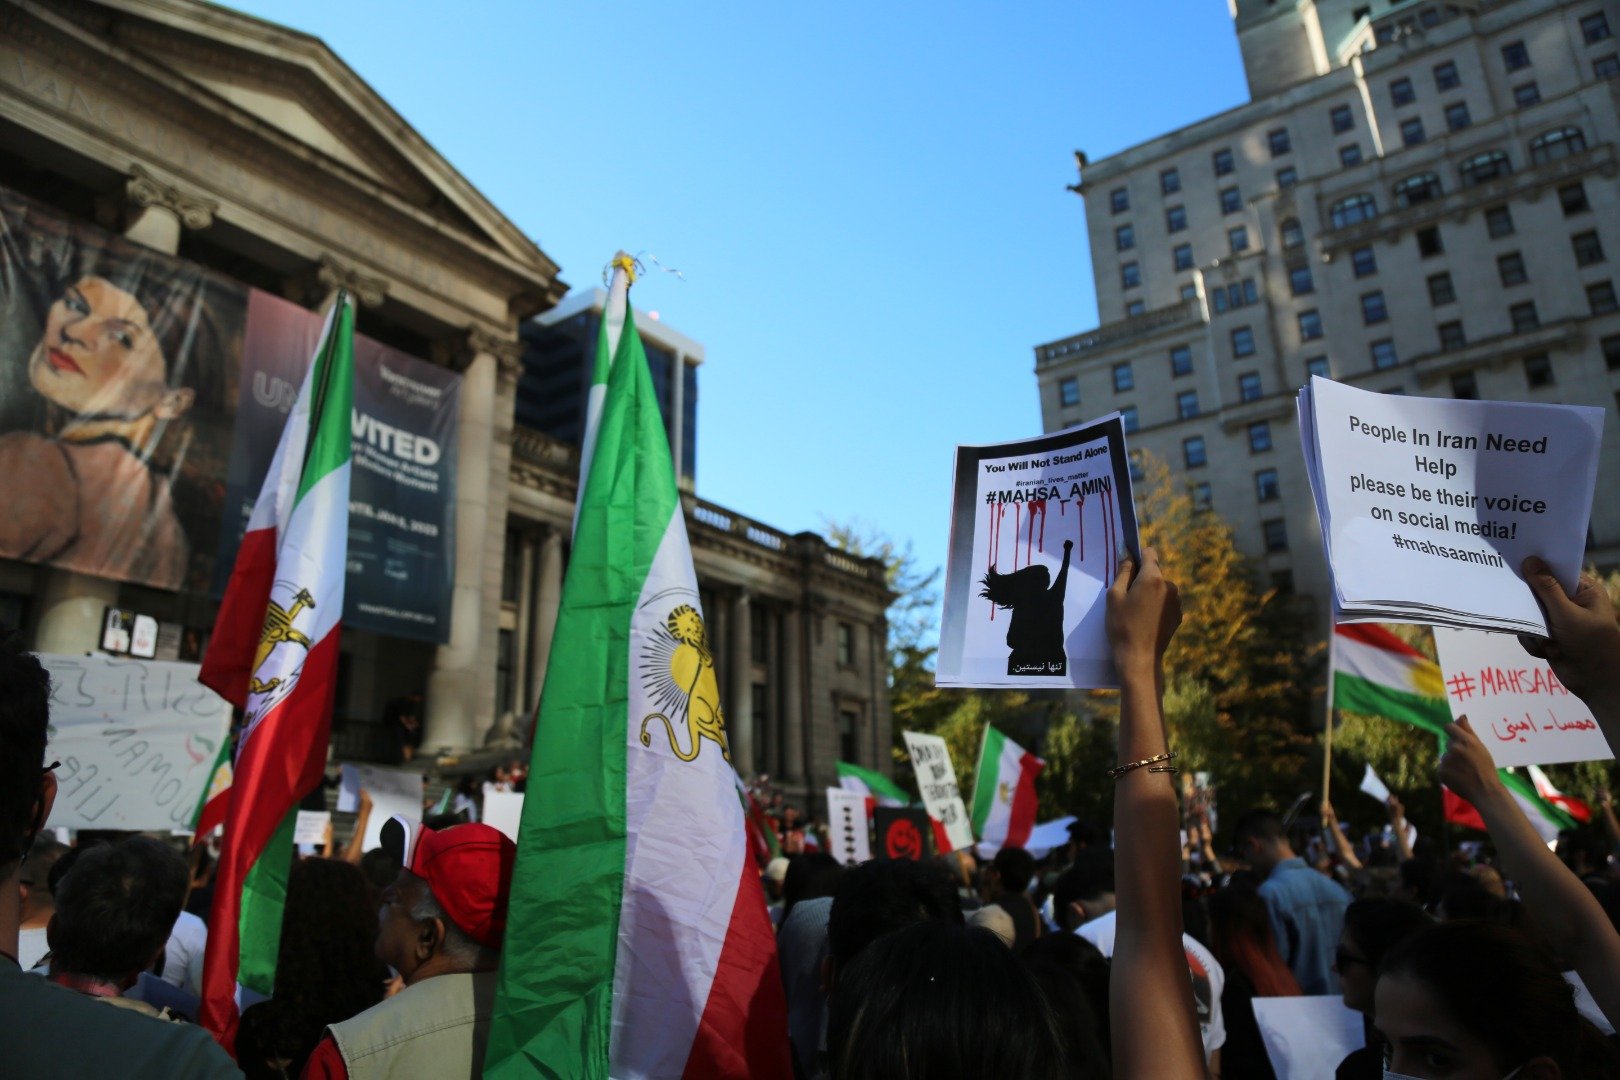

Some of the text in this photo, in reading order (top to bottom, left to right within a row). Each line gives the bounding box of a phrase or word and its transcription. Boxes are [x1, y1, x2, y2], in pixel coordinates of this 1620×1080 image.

[1349, 415, 1548, 454] People In Iran Need
[985, 445, 1108, 473] You Will Not Stand Alone
[1414, 455, 1458, 478] Help
[986, 475, 1112, 505] #MAHSA_AMINI
[1350, 473, 1547, 514] please be their voice
[1370, 505, 1518, 540] on social media!
[1392, 533, 1504, 569] #mahsaamini
[1048, 661, 1063, 673] تنها
[1446, 665, 1569, 702] #MAHSAA
